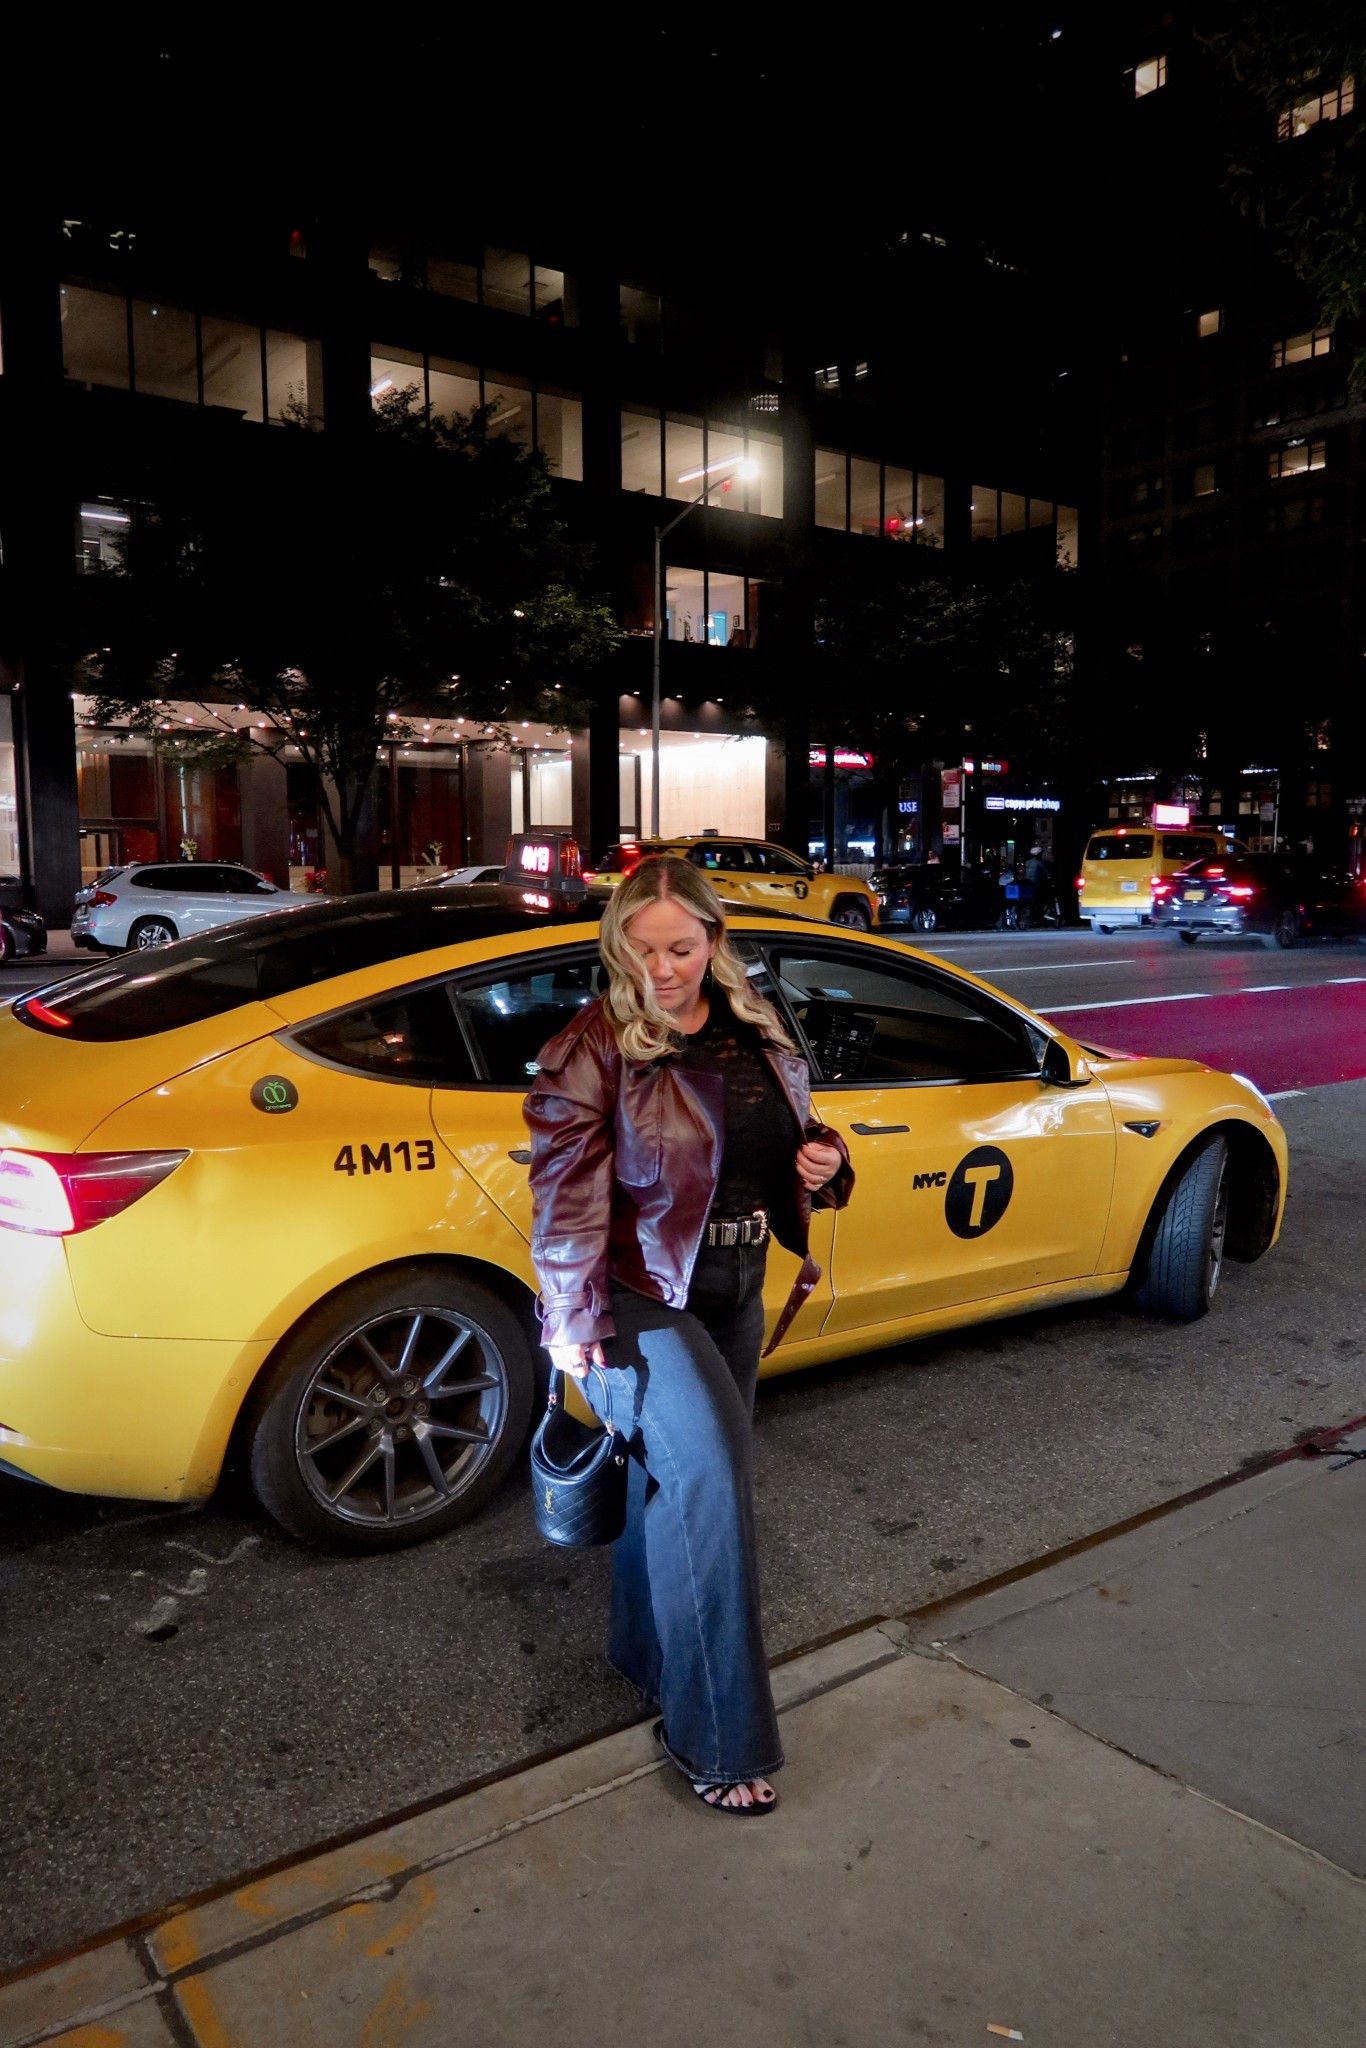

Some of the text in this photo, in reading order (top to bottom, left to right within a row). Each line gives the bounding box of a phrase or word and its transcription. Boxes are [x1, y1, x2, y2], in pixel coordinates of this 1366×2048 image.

[333, 1139, 436, 1177] 4M13
[912, 1164, 1001, 1227] NYC T
